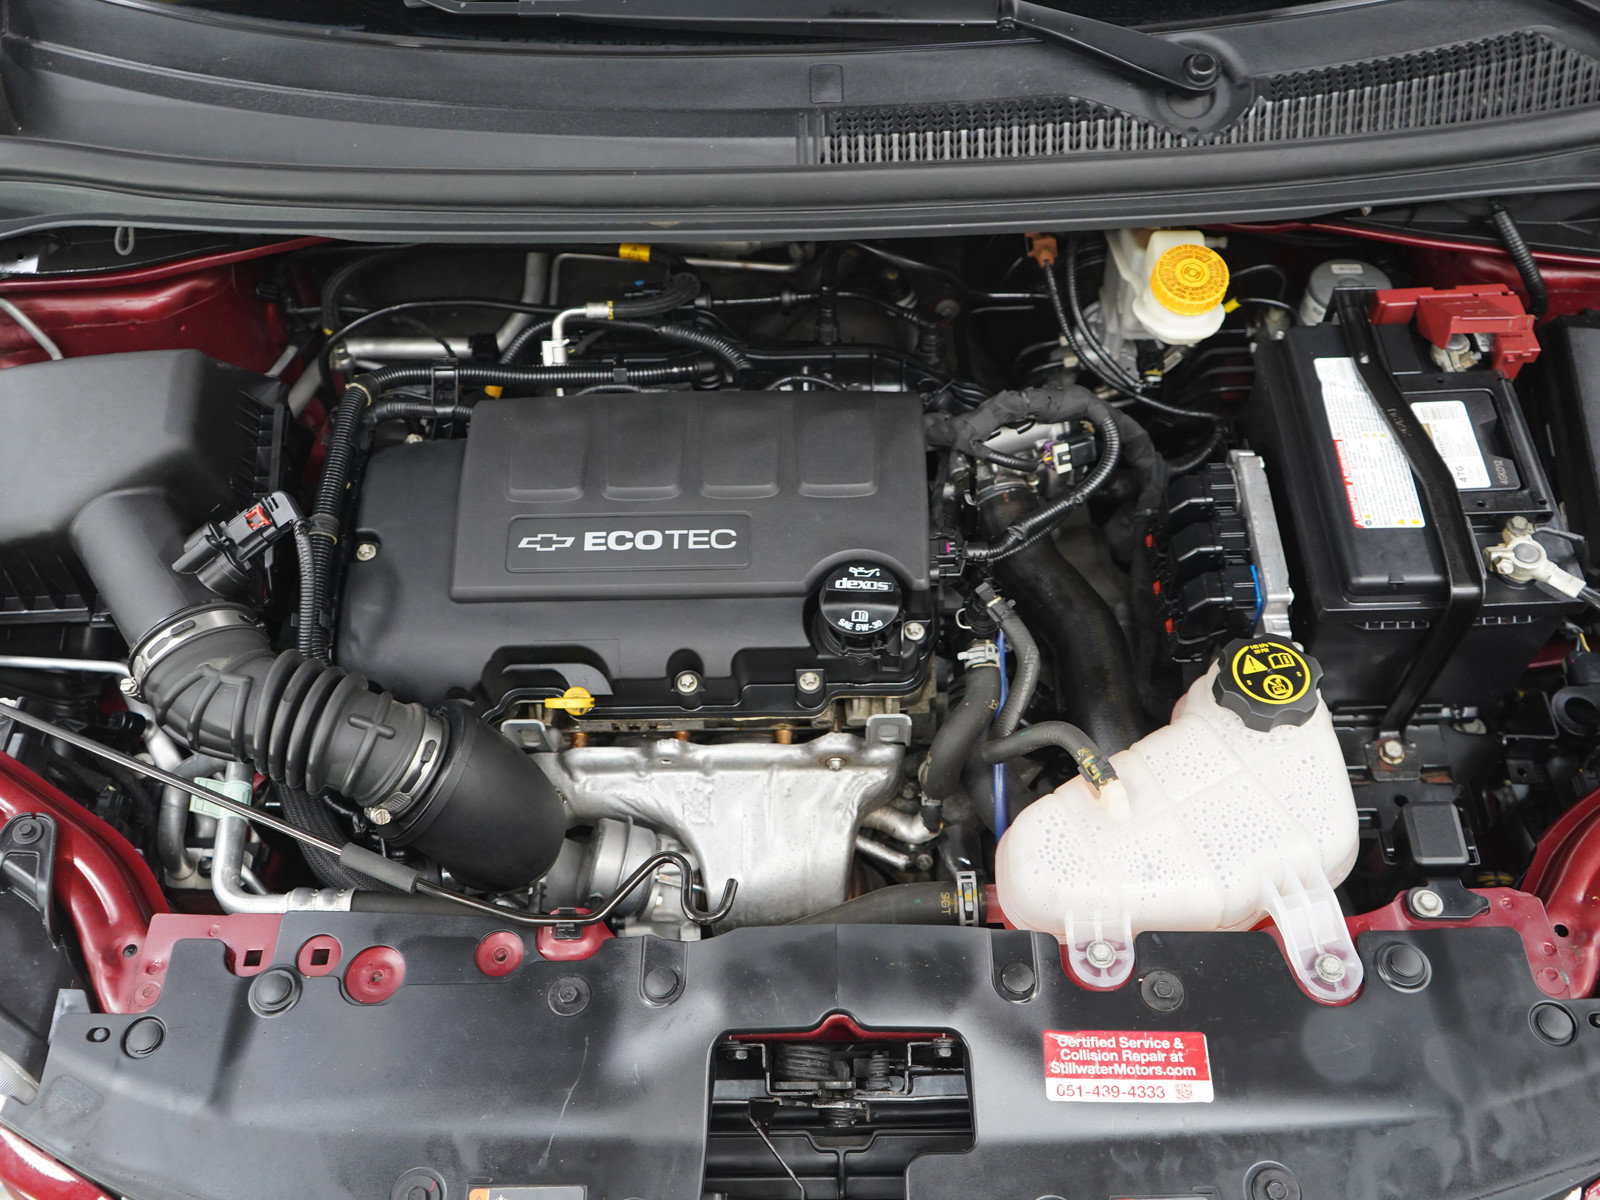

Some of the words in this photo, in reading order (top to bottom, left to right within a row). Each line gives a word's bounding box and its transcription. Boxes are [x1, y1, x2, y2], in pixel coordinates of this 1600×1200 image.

[584, 529, 738, 551] ECOTEC
[835, 577, 890, 591] dexos
[838, 618, 854, 630] SAE
[855, 620, 883, 631] 5W-30
[1057, 1036, 1116, 1048] Certified
[1119, 1037, 1170, 1049] Service
[1173, 1037, 1184, 1049] &
[1060, 1049, 1118, 1061] Collision
[1122, 1050, 1167, 1064] Repair
[1170, 1050, 1184, 1063] at
[1050, 1061, 1196, 1076] StillwaterMotors.com
[1056, 1083, 1166, 1099] 651-439-4333
